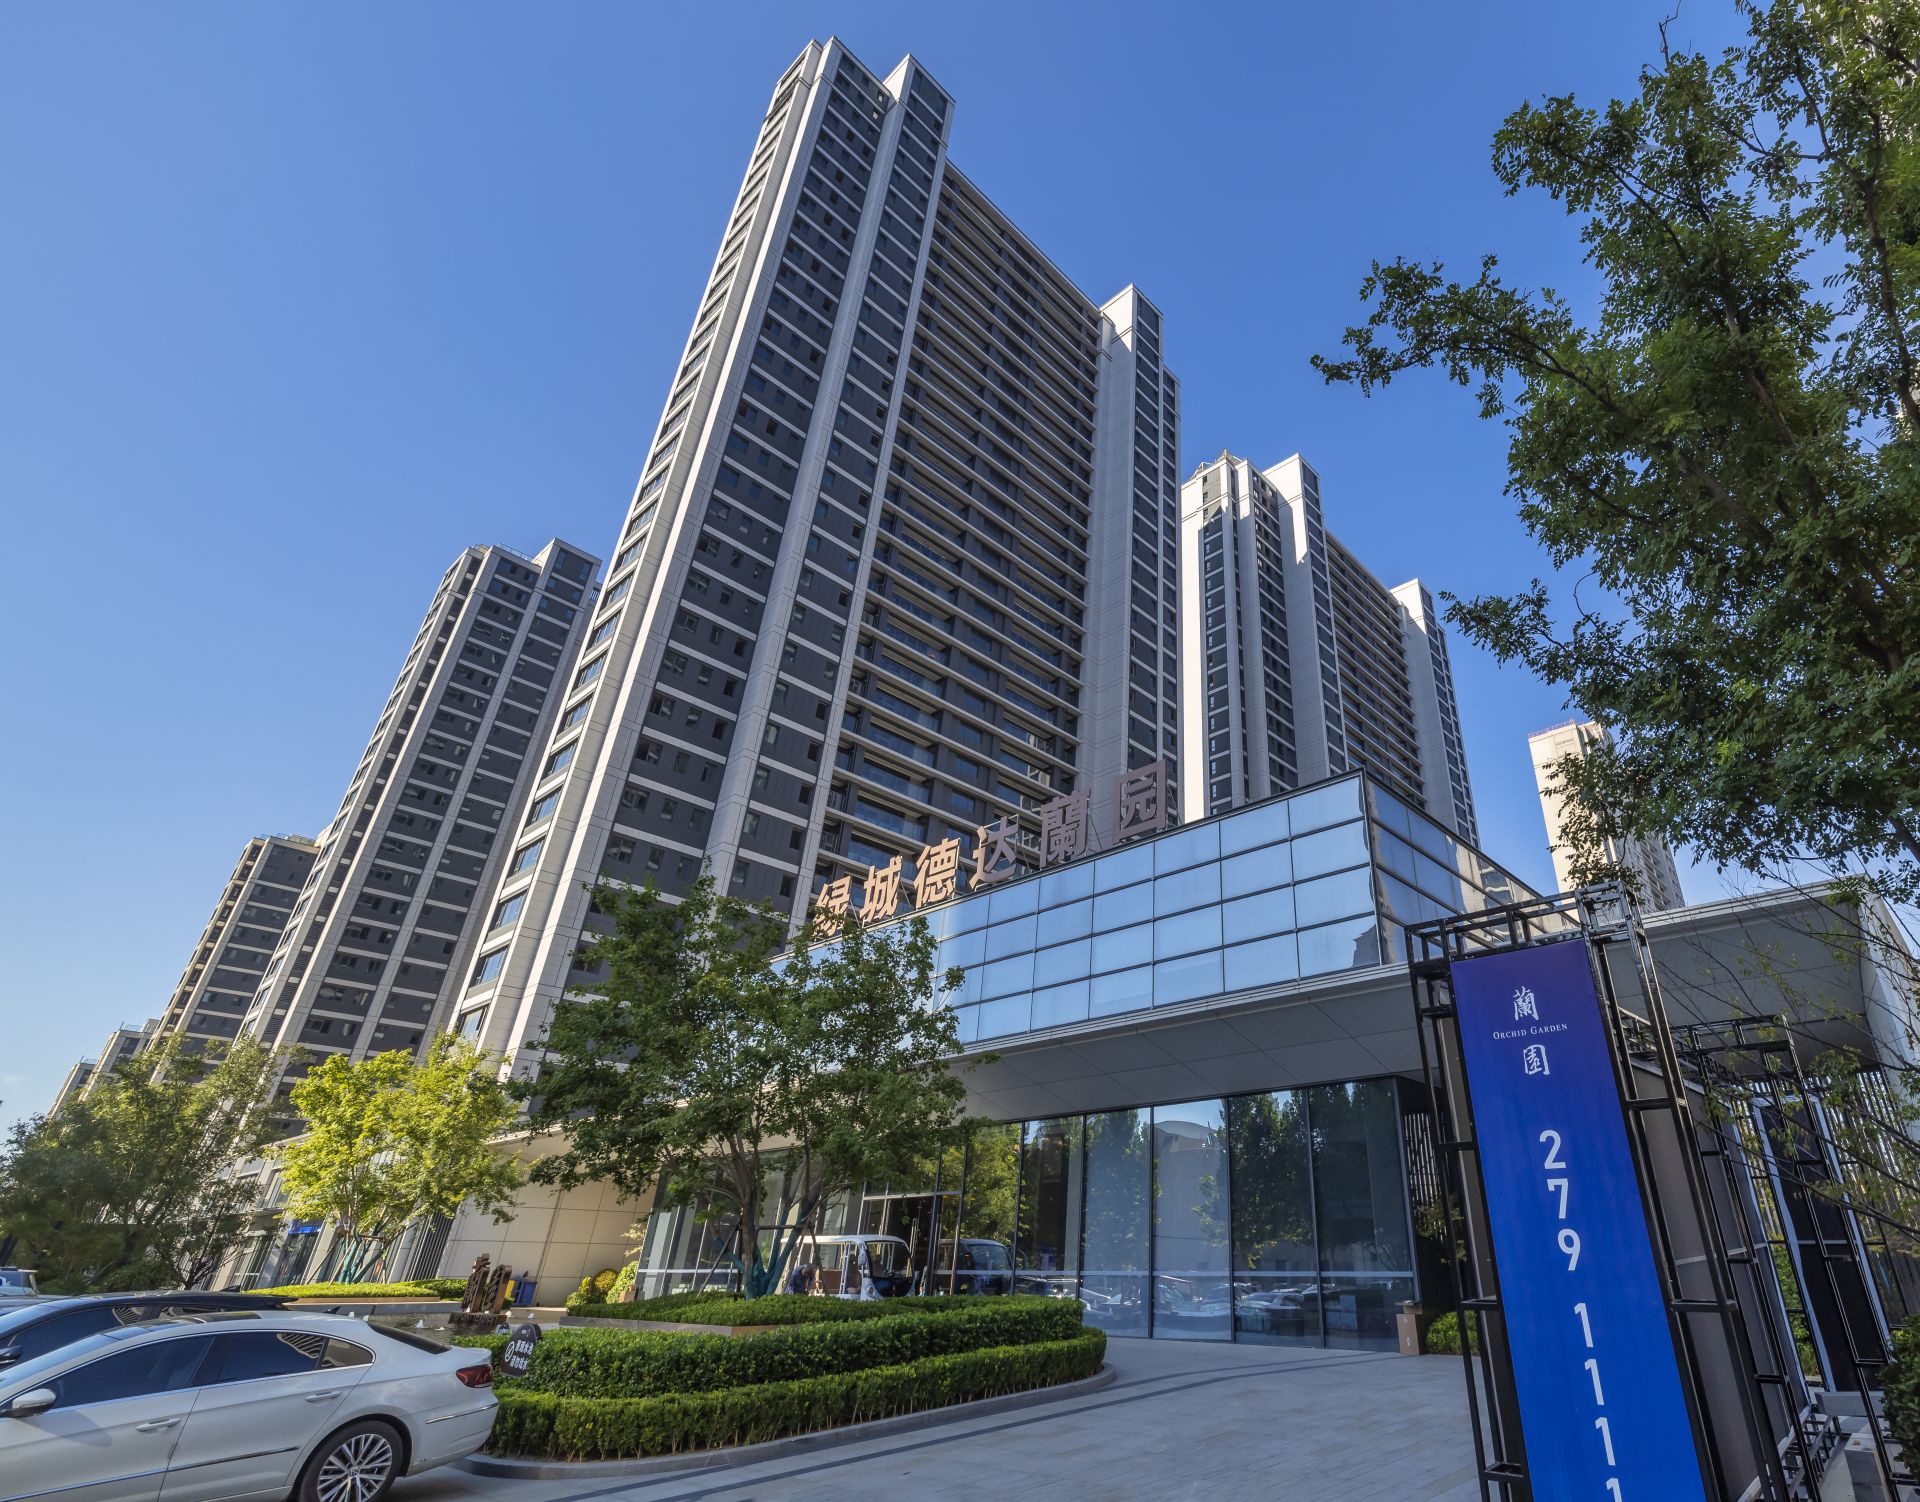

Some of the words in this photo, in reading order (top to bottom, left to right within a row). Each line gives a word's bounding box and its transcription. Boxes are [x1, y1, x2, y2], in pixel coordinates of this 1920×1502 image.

[1513, 985, 1539, 1020] 蘭
[1493, 1028, 1527, 1040] ORCHID
[1530, 1023, 1568, 1035] GARDEN
[1539, 1129, 1581, 1271] 279
